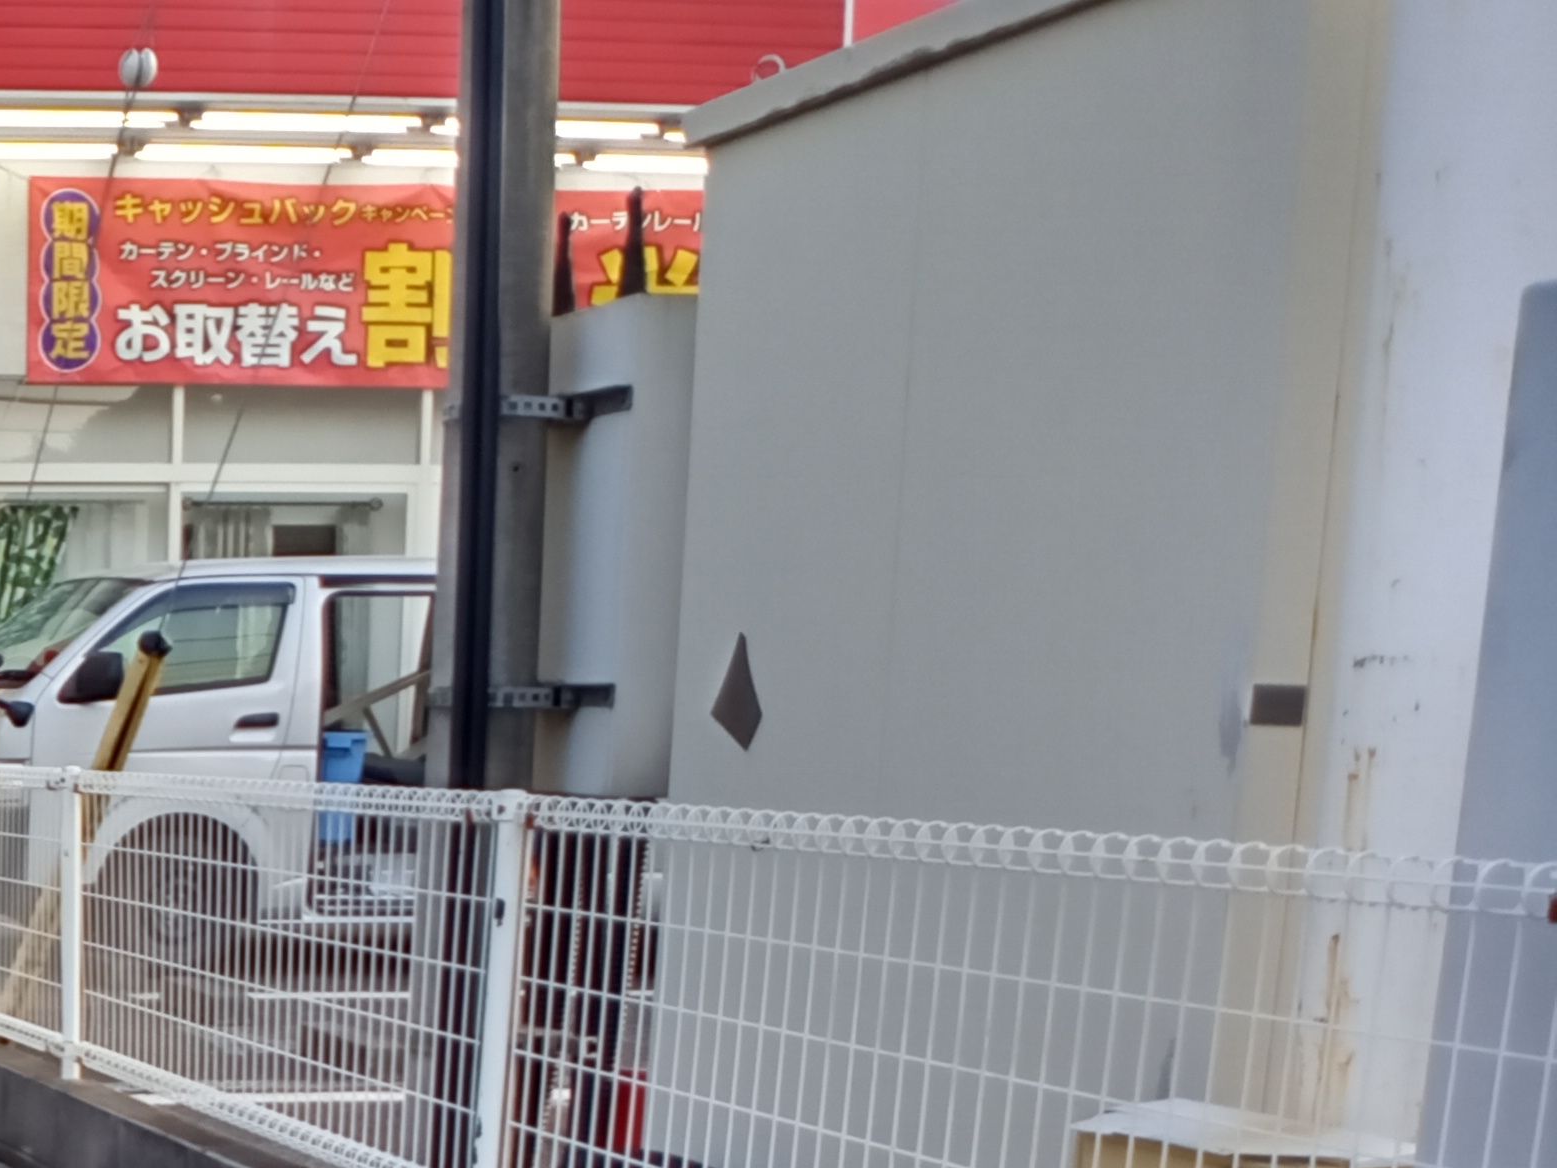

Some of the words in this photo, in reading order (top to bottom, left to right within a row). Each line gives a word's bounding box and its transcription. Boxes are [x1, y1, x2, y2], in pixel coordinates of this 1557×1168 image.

[49, 201, 90, 360] 期間限定
[150, 270, 355, 291] スクリーン・レールなど
[115, 302, 358, 367] お取替え
